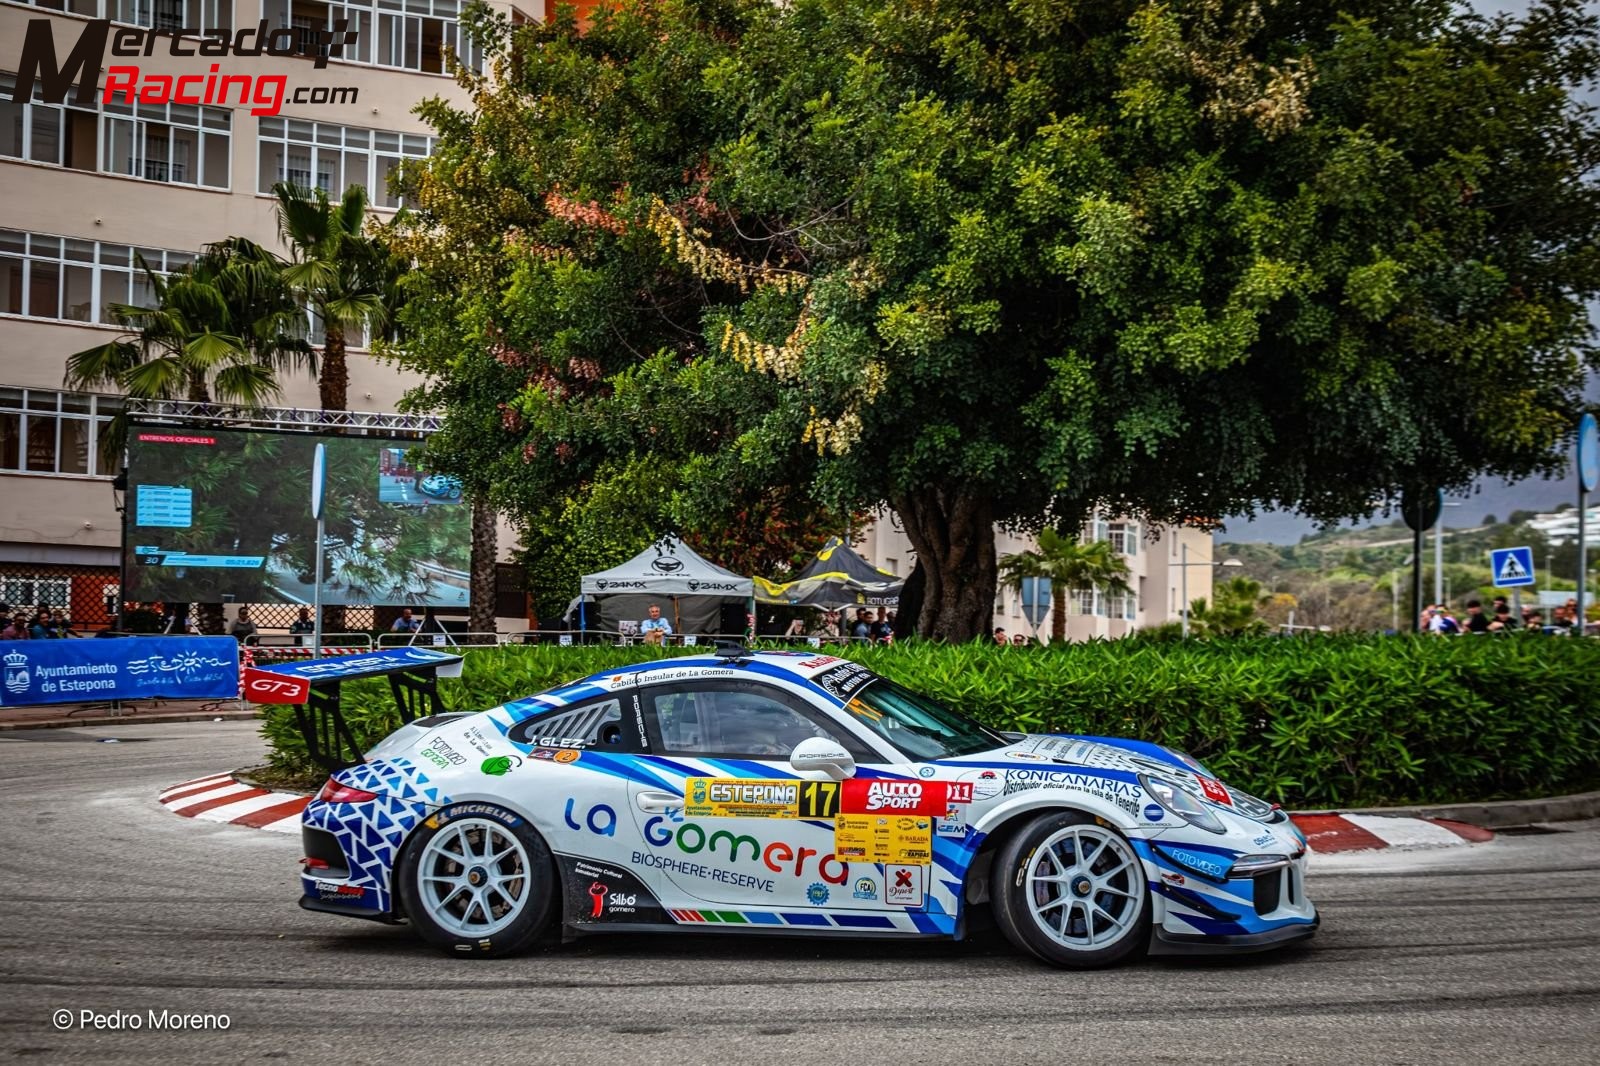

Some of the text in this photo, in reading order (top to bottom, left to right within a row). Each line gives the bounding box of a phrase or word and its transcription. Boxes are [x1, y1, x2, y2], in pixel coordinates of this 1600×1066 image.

[139, 434, 175, 442] ENTRENOS
[175, 436, 209, 444] OFICIALES
[701, 582, 738, 591] 24MX
[35, 663, 118, 679] Ayuntamiento
[610, 668, 734, 689] Cabildo Insular de La Gomera
[41, 679, 116, 692] de Estepona
[251, 678, 301, 697] GT3
[632, 694, 648, 748] PORSCHE
[562, 752, 572, 760] 2
[868, 782, 923, 798] AUTO
[1005, 769, 1142, 798] KONICANARIAS
[709, 783, 799, 803] ESTEPONA
[805, 782, 837, 817] 17
[1003, 780, 1042, 796] Distribuidor
[1091, 788, 1104, 798] isla
[1105, 791, 1114, 801] de
[1115, 793, 1140, 818] Tenerife
[865, 795, 921, 811] SPORT
[450, 804, 517, 824] MICHELIN
[644, 814, 849, 886] Gomera
[577, 861, 623, 879] Patrimonio Cultural
[860, 882, 871, 892] FCA
